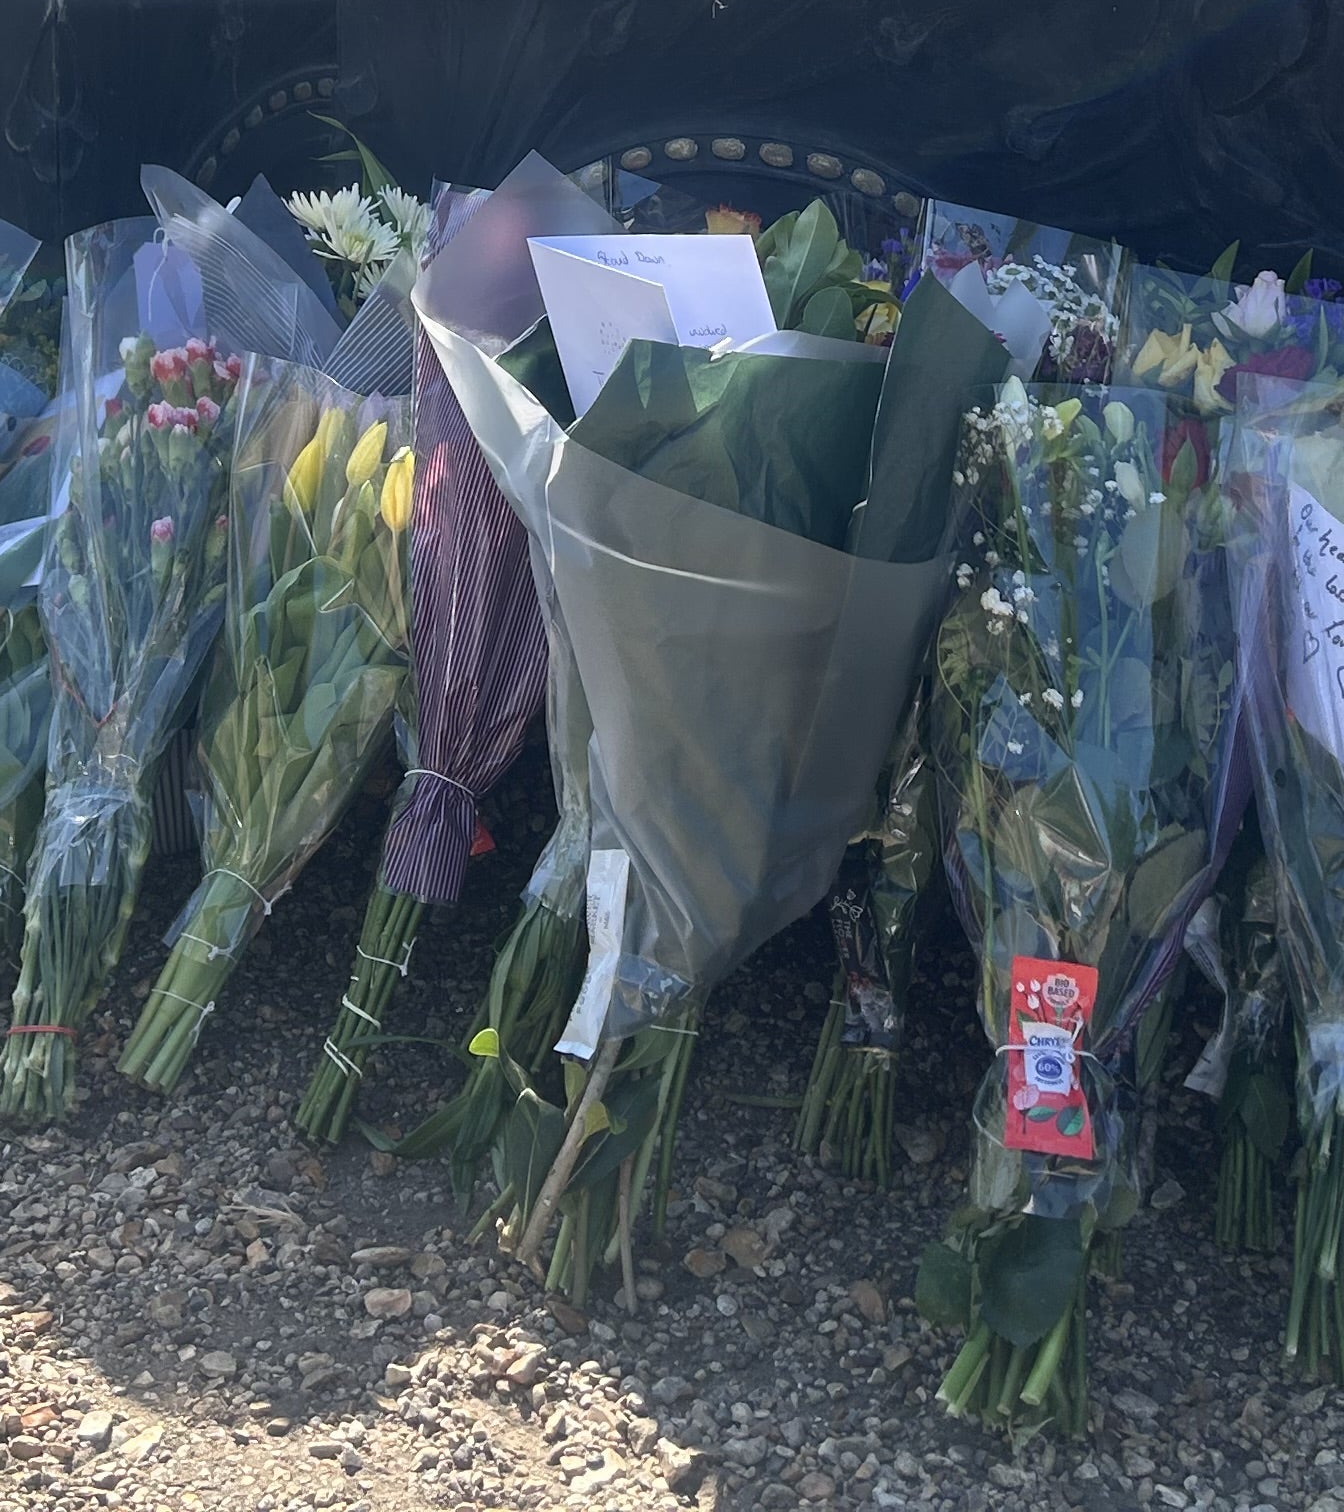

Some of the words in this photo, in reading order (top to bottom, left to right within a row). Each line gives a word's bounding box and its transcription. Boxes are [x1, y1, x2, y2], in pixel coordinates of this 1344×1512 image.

[1054, 978, 1070, 988] BIO
[1047, 986, 1075, 998] BASED
[1038, 1061, 1061, 1075] 60%
